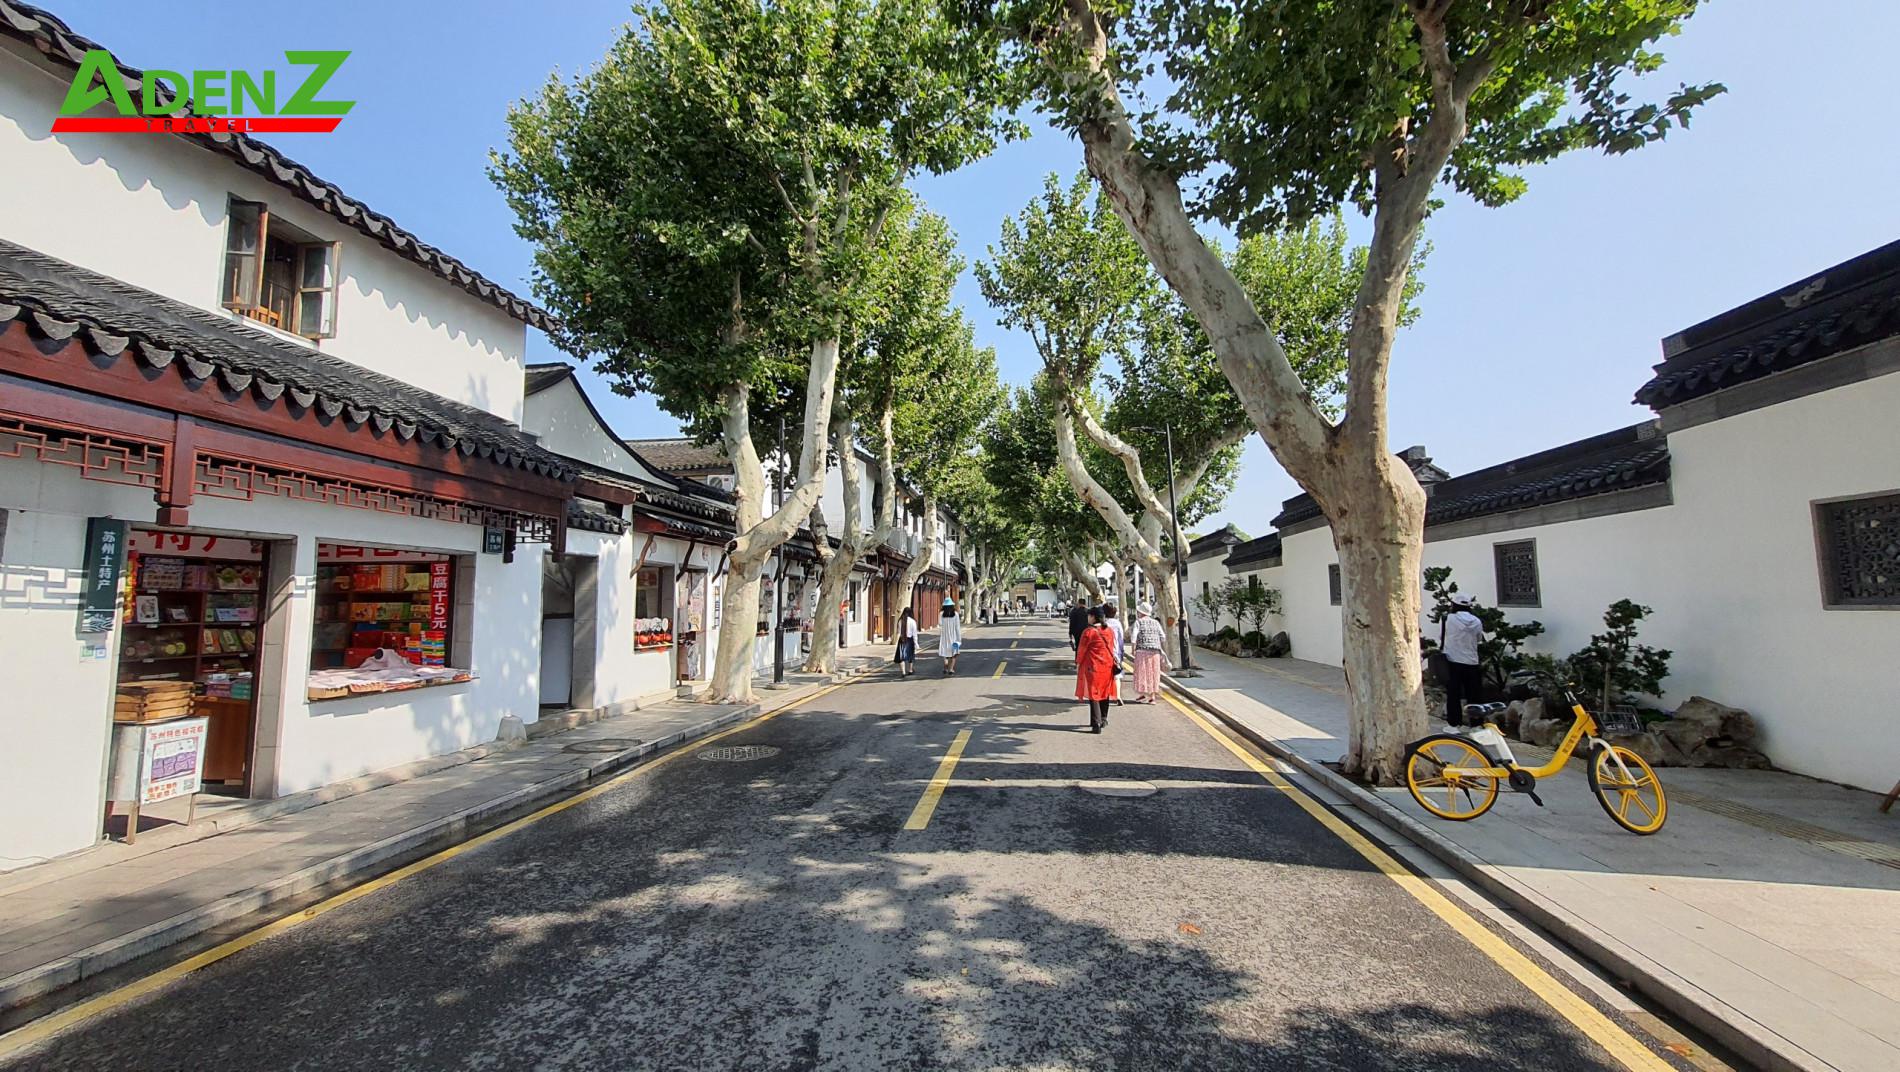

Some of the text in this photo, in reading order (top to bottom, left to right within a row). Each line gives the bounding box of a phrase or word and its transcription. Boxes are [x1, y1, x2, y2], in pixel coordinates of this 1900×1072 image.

[96, 531, 116, 591] 苏州土特产
[432, 563, 448, 630] 豆腐干5元
